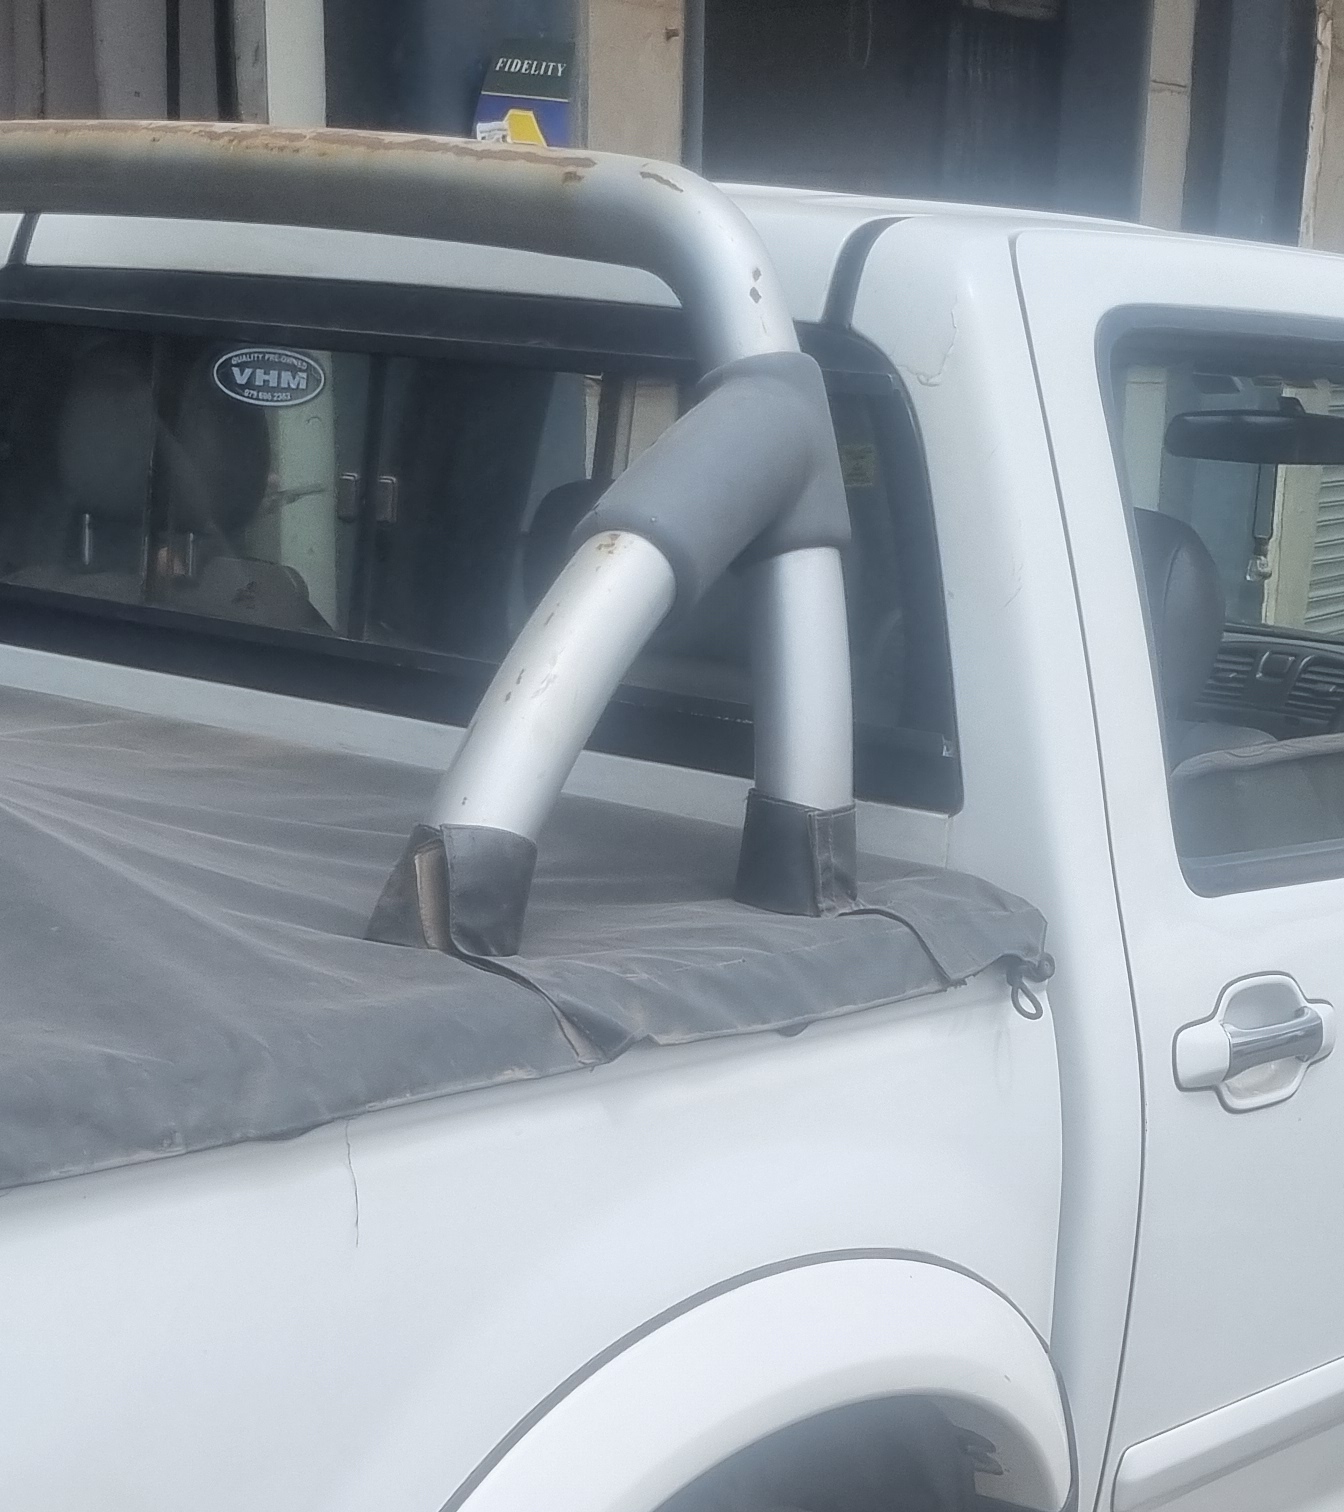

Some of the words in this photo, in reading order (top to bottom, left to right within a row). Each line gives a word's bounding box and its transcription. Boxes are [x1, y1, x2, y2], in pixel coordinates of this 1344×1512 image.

[495, 57, 567, 77] FIDELITY
[231, 353, 264, 365] QUALITY
[231, 366, 308, 390] VHM
